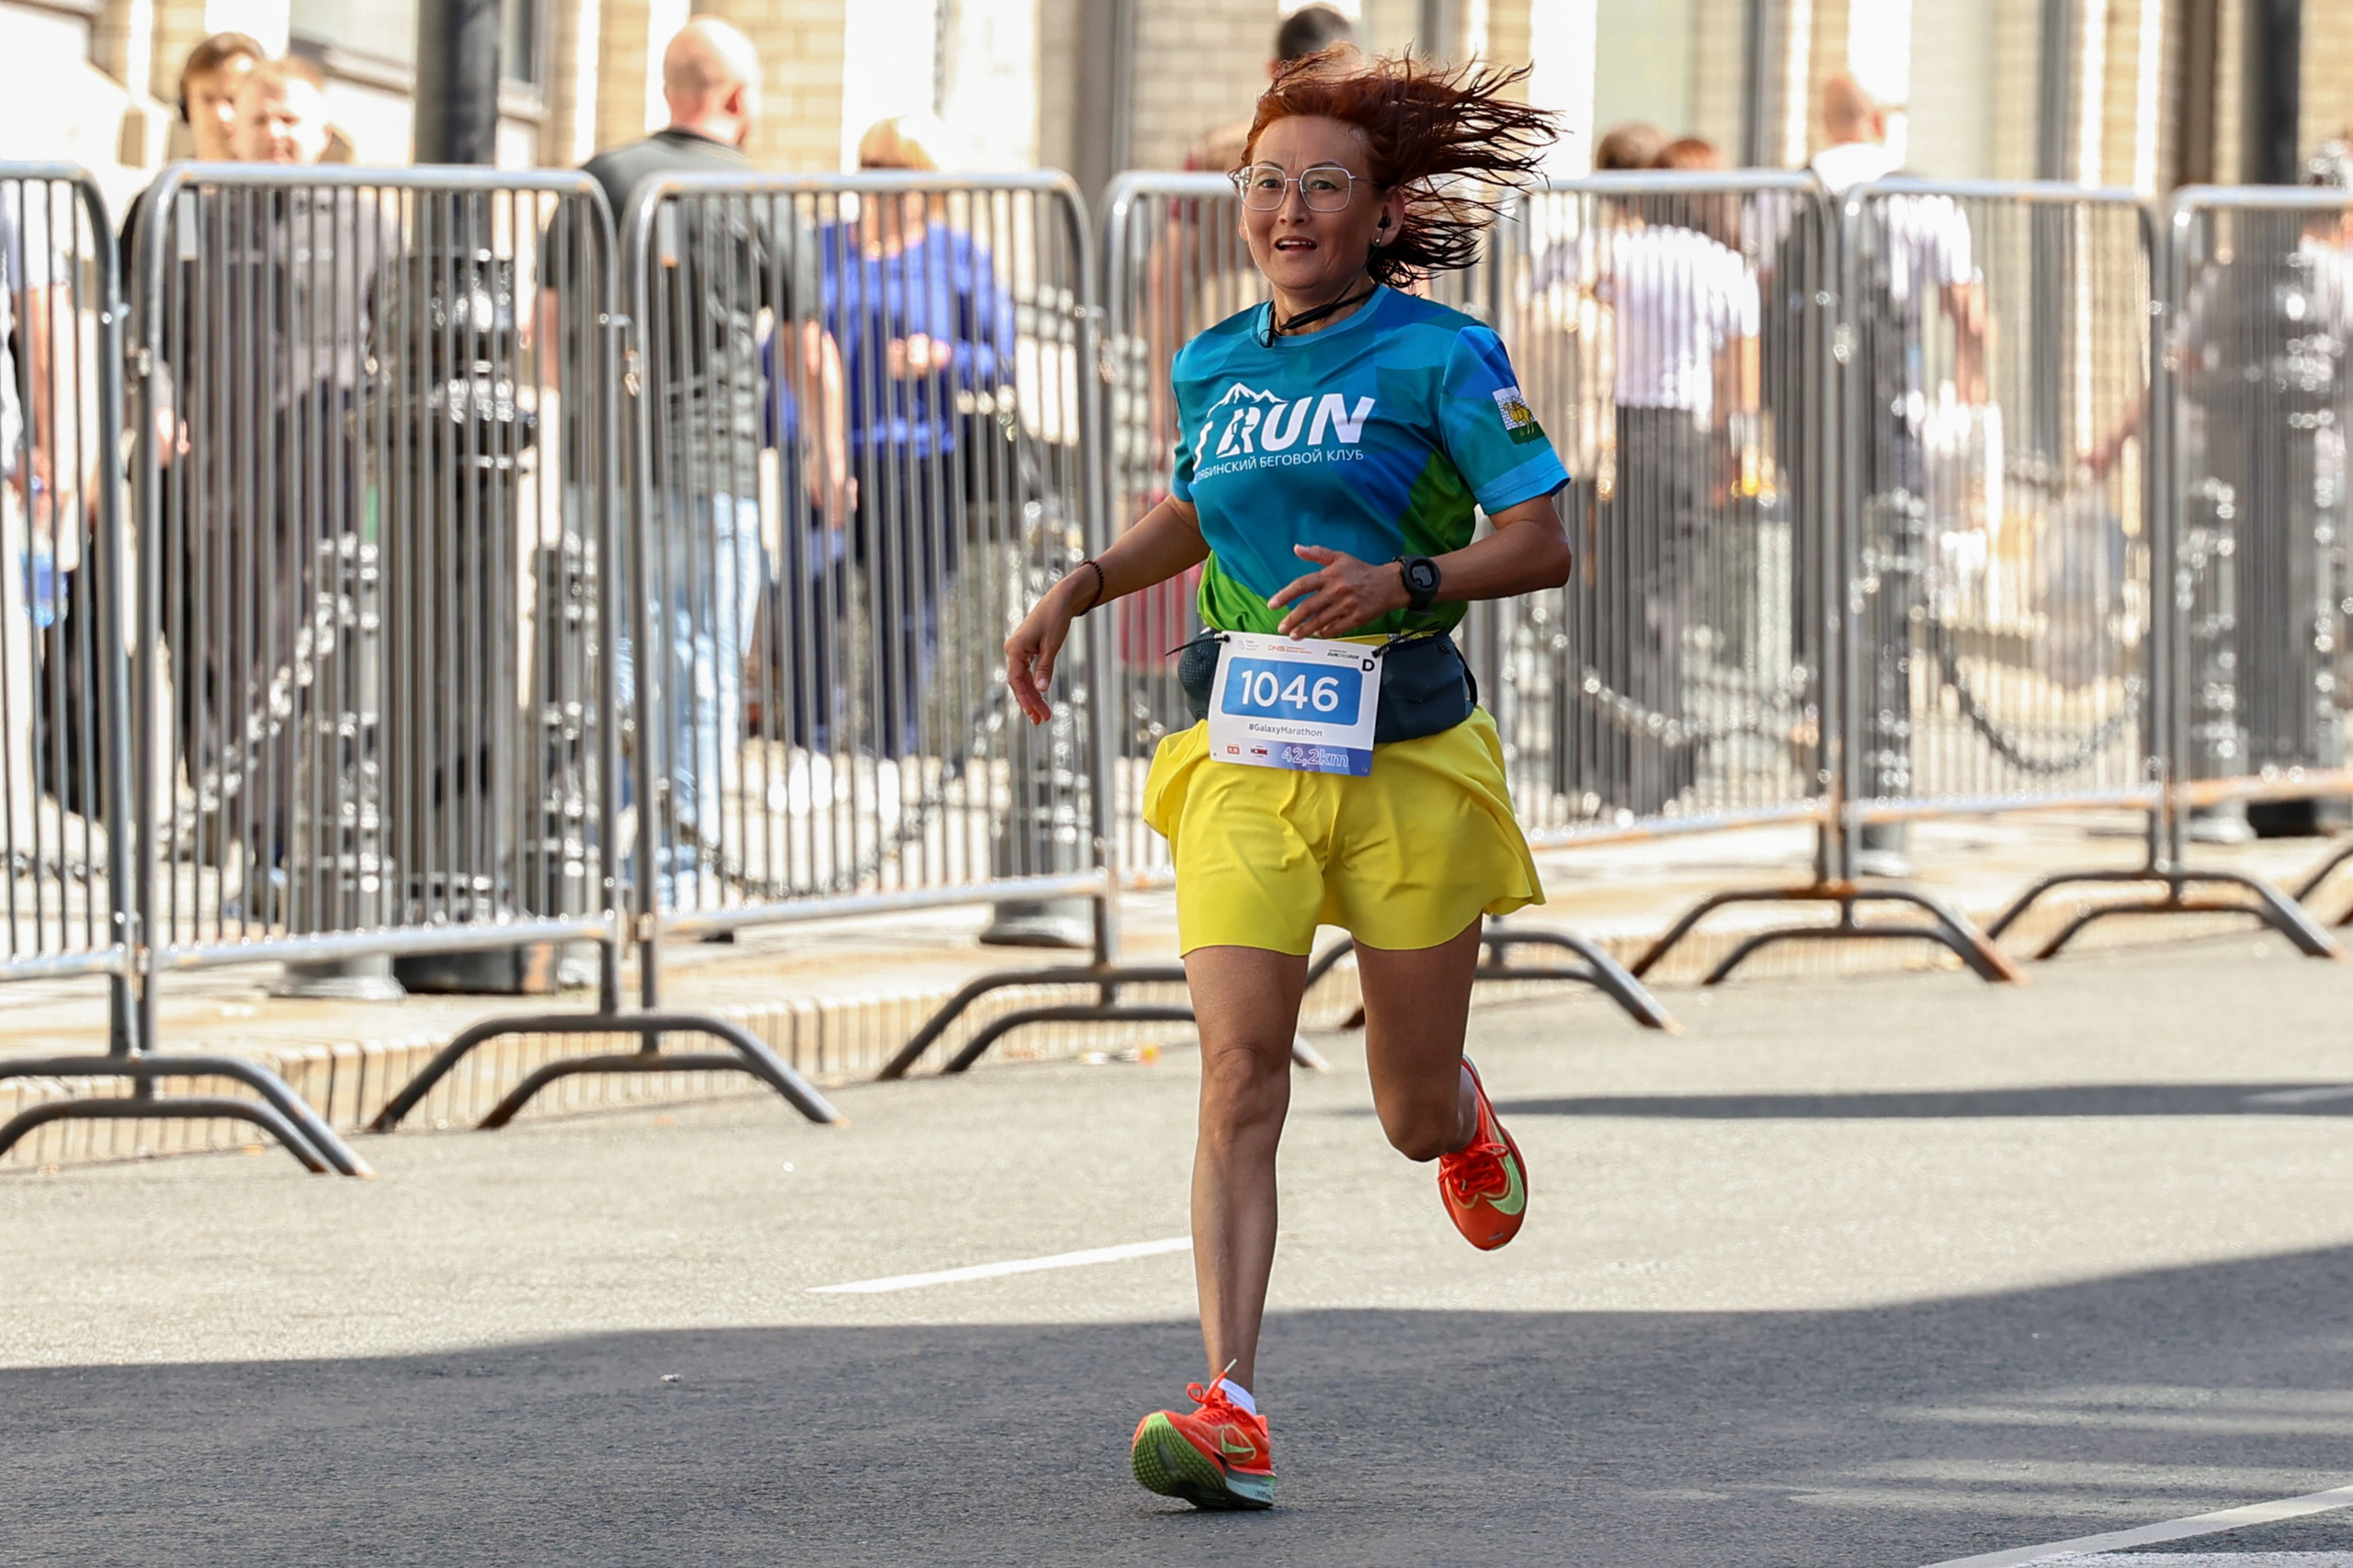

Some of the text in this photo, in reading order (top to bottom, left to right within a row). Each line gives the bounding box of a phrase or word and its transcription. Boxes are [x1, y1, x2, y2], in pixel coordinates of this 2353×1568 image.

[1259, 448, 1323, 468] БЕГОВОЙ
[1326, 449, 1364, 462] КЛУБ
[1362, 658, 1375, 672] D
[1241, 669, 1340, 712] 1046
[1248, 722, 1323, 738] #GalaxyMarathon
[1281, 745, 1349, 768] 42,2km
